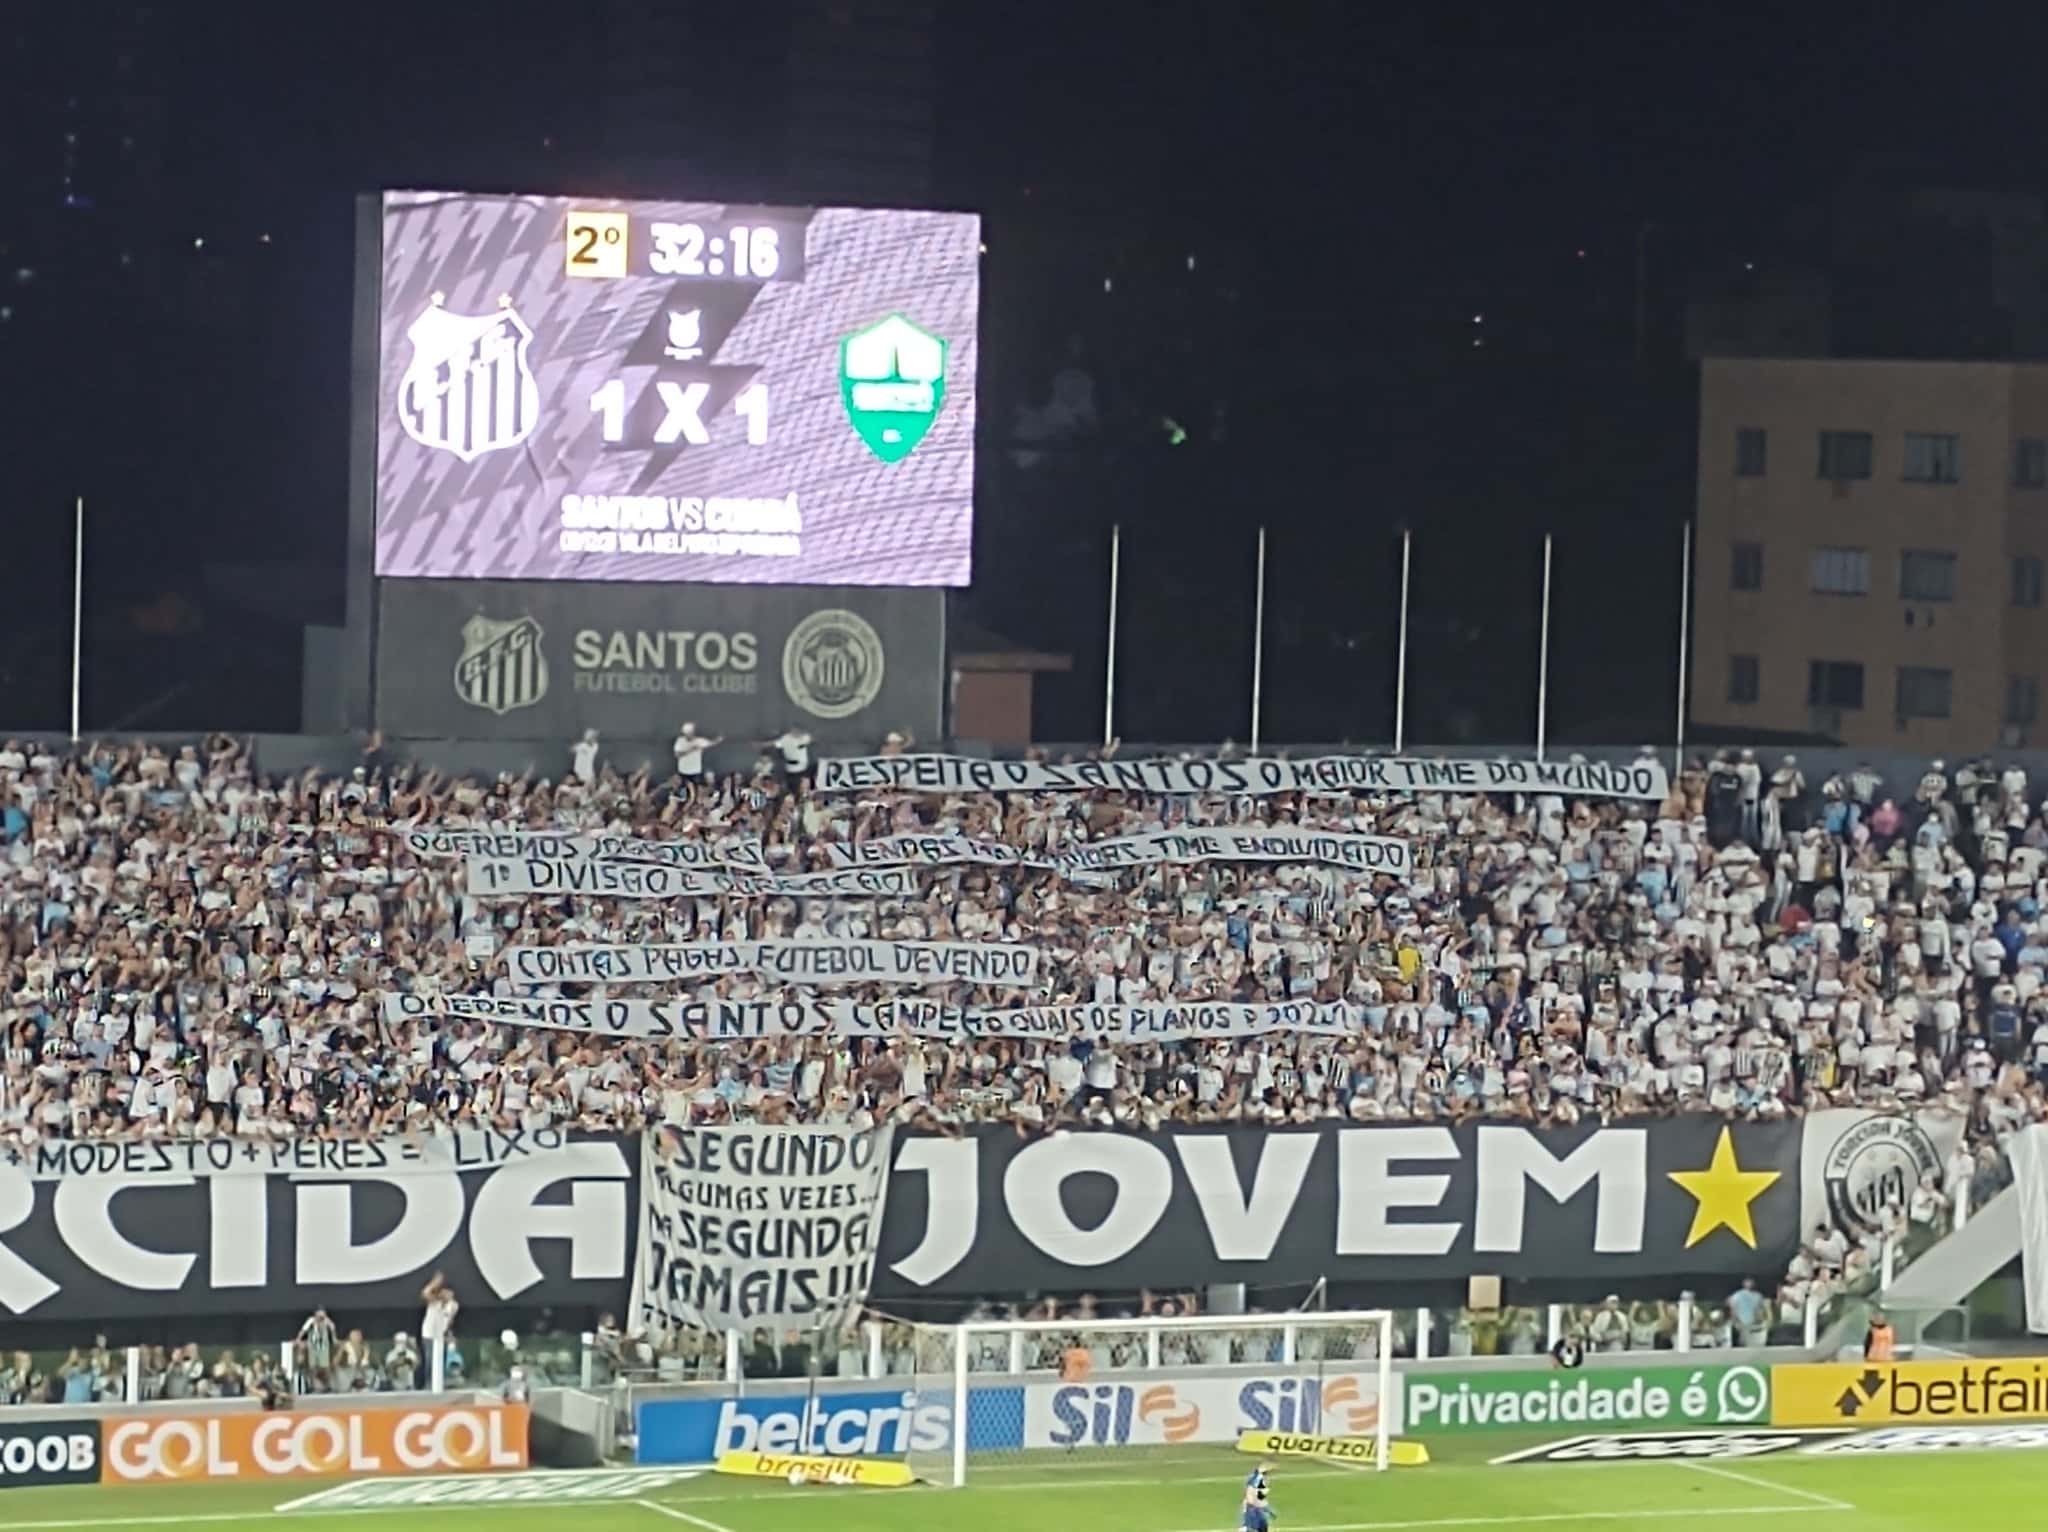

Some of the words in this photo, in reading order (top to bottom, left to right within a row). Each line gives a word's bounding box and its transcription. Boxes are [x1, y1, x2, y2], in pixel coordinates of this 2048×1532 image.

[649, 222, 779, 276] 32:16
[590, 380, 626, 443] 1
[735, 384, 769, 445] 1
[573, 630, 758, 671] SANTOS
[573, 672, 677, 694] FUTEBOL
[683, 673, 758, 695] CLUBE
[824, 758, 995, 789] RESPEITA
[1043, 758, 1249, 792] SANTOS
[1258, 761, 1283, 788] O
[1291, 757, 1387, 789] MAIOR
[1394, 760, 1478, 785] TIME
[1488, 761, 1528, 785] DO
[1534, 762, 1652, 796] MUNDO
[517, 949, 632, 980] CONTAS
[757, 945, 886, 974] FUTEBOL
[893, 944, 1030, 977] DEVENDO
[648, 1001, 836, 1037] SANTOS
[1090, 1008, 1122, 1031] OS
[1130, 1006, 1231, 1034] PLANOS
[36, 1139, 233, 1175] MODESTO
[270, 1137, 388, 1170] PERES
[452, 1128, 562, 1165] LIXO
[678, 1208, 871, 1259] SEGUNDA
[888, 1126, 1649, 1287] JOVEM
[713, 1391, 951, 1458] betcris
[1050, 1385, 1134, 1445] Sil
[1237, 1378, 1322, 1435] Sil
[1408, 1375, 1669, 1425] Privacidade
[1681, 1371, 1706, 1417] é
[109, 1420, 238, 1478] GOL
[252, 1415, 380, 1472] GOL
[394, 1410, 519, 1470] GOL
